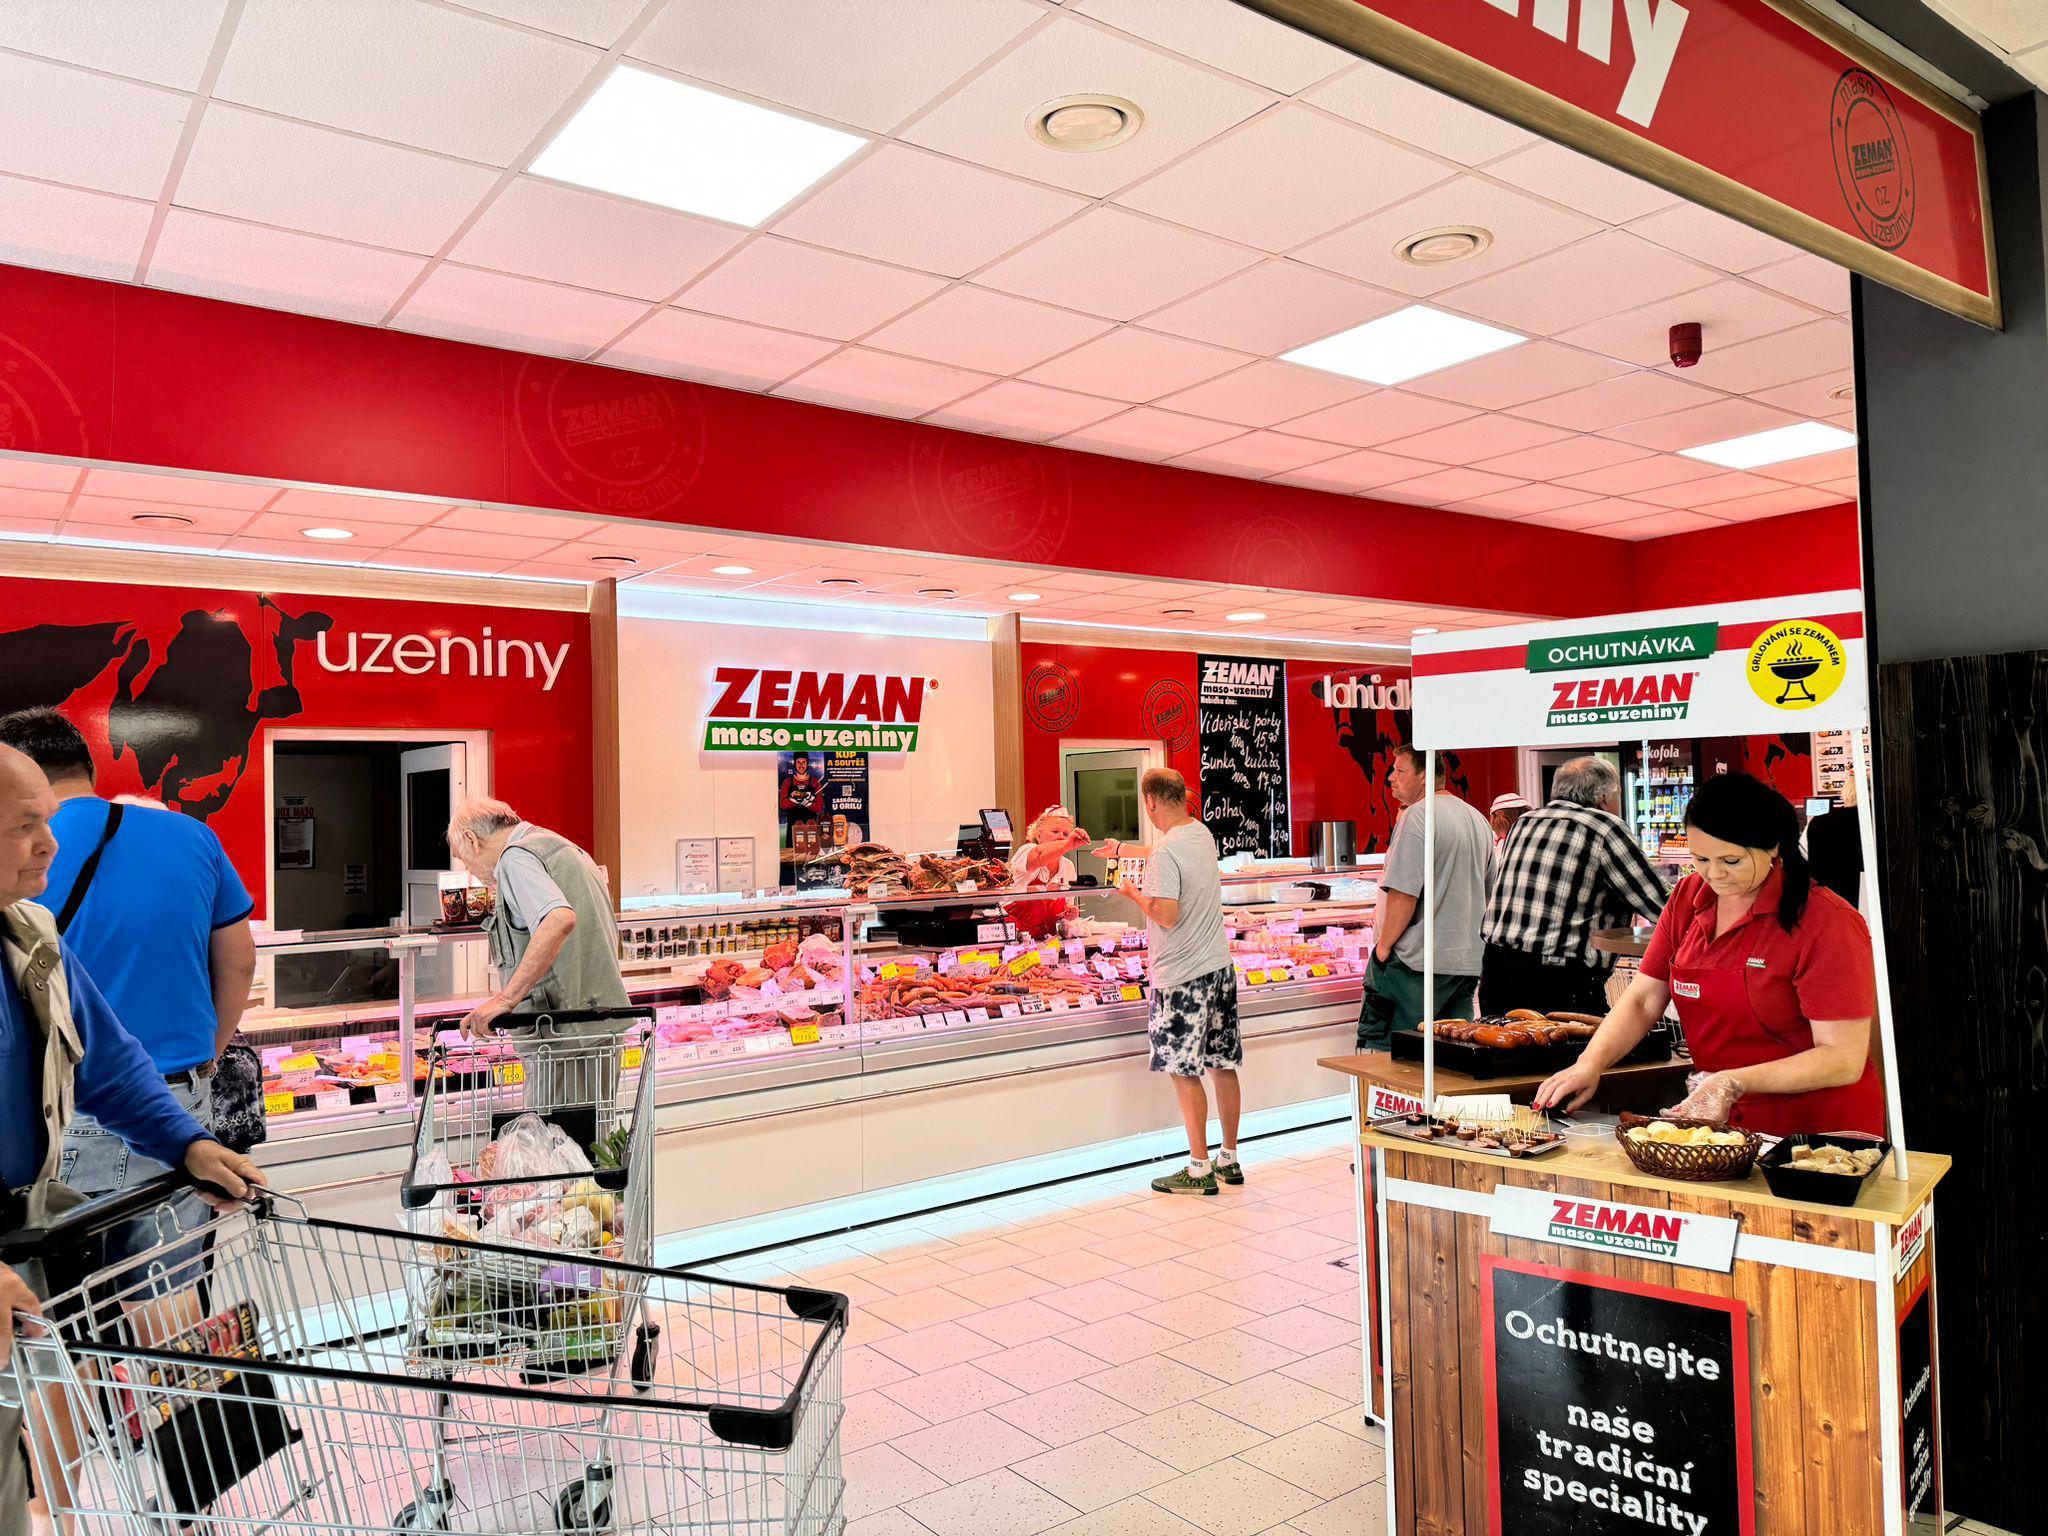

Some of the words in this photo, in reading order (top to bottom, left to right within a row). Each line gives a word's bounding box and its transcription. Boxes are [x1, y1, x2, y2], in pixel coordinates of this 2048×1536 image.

[1839, 76, 1875, 107] maso
[1851, 138, 1893, 167] ZEMAN
[1874, 185, 1891, 206] CZ
[1870, 207, 1910, 243] uzeniny
[562, 392, 658, 432] ZEMAN
[611, 445, 645, 469] CZ
[316, 626, 571, 691] uzeniny
[1548, 635, 1696, 664] OCHUTNÁVKA
[1751, 627, 1788, 673] GRILOVÁNÍ
[1789, 627, 1802, 636] SE
[1803, 627, 1841, 667] ZEMANEM
[1202, 660, 1276, 687] ZEMAN
[707, 666, 926, 723] ZEMAN
[1203, 684, 1272, 698] maso-uzeniny
[1550, 672, 1694, 710] ZEMAN
[1550, 705, 1687, 726] maso-uzeniny
[711, 725, 915, 752] maso-uzeniny
[1648, 743, 1681, 763] kofola
[827, 759, 834, 767] A
[835, 757, 865, 767] SOUTĚŽ
[835, 751, 857, 759] KUP
[832, 803, 839, 811] U
[839, 803, 862, 811] GRILU
[1674, 981, 1699, 994] ZEMAN
[1551, 1199, 1682, 1242] ZEMAN
[1900, 1207, 1923, 1259] ZEMAN
[1551, 1224, 1676, 1256] maso-uzeniny
[1505, 1310, 1721, 1381] Ochutnejte
[1566, 1404, 1655, 1444] naše
[1536, 1429, 1695, 1494] tradiční
[1523, 1468, 1709, 1536] speciality
